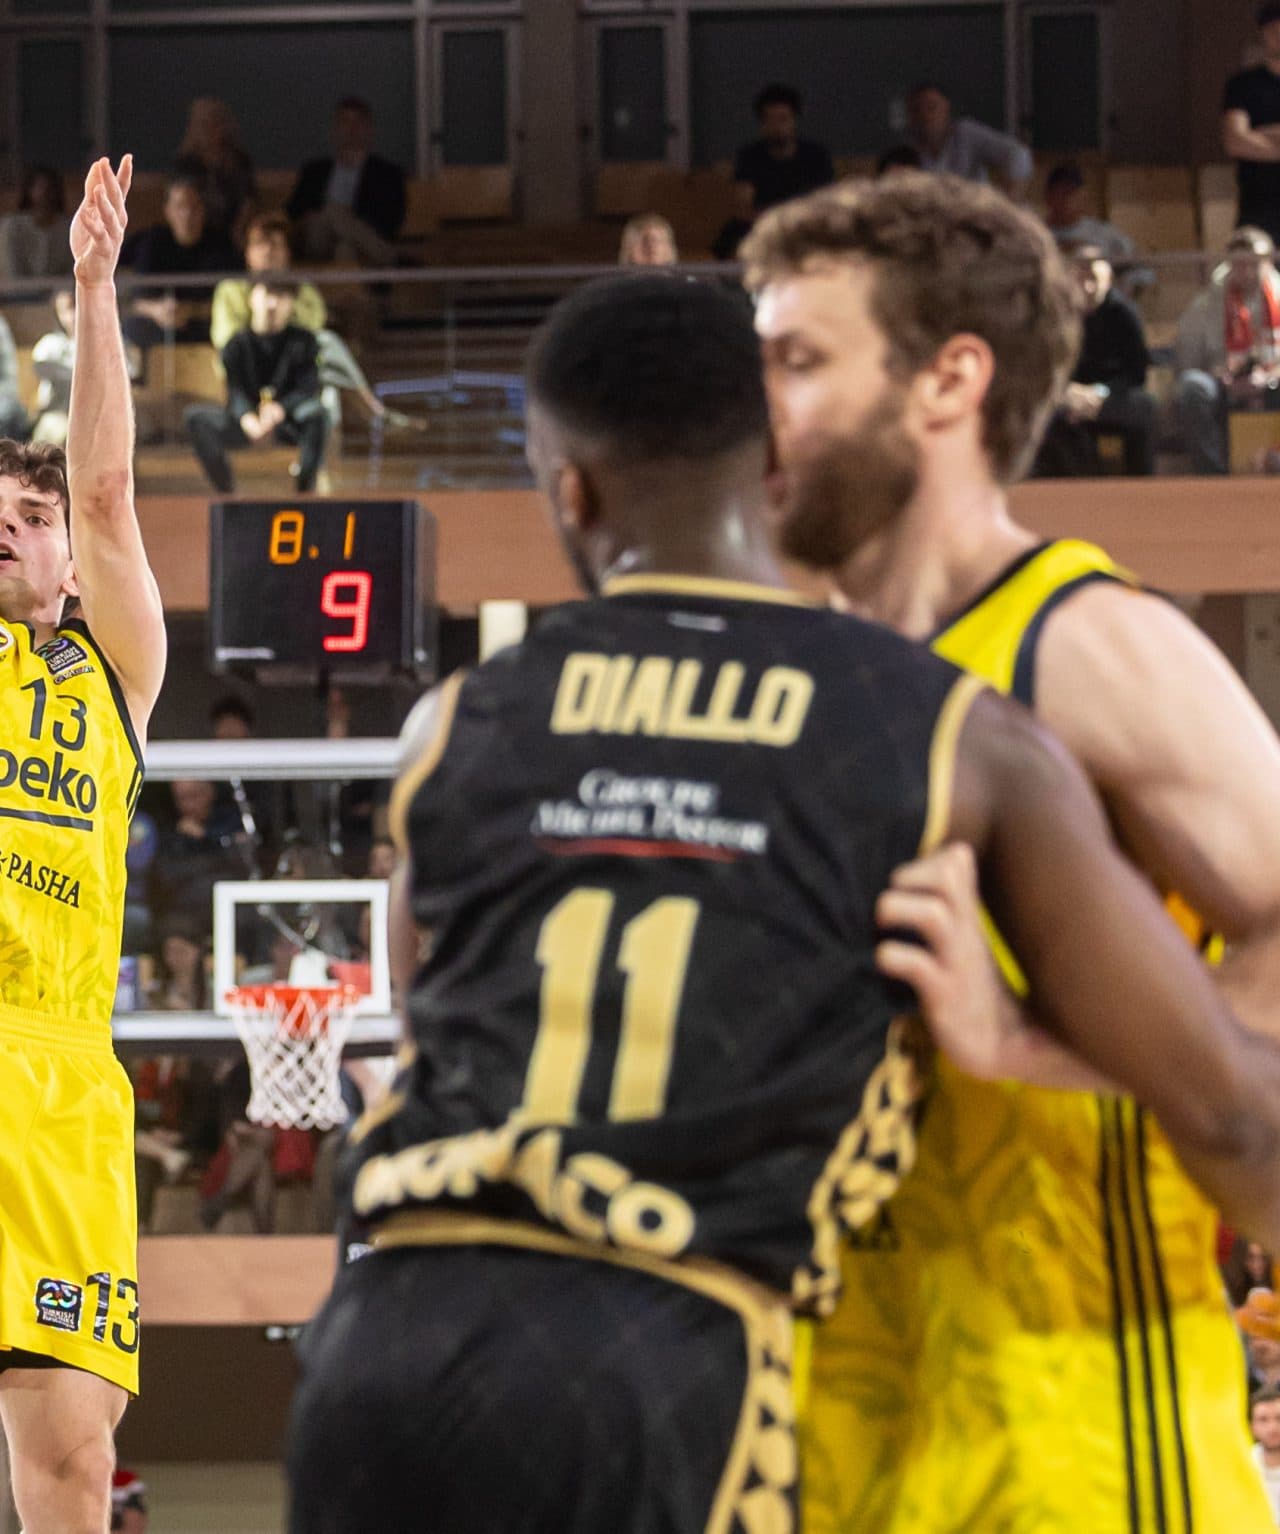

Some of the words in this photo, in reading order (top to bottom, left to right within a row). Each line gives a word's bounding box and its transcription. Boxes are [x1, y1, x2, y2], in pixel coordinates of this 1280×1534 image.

[270, 510, 356, 564] 8.1
[321, 571, 372, 652] 9
[20, 678, 87, 751] 13
[550, 652, 814, 747] DIALLO
[7, 853, 80, 908] PASHA
[521, 886, 699, 1126] 11
[86, 1272, 138, 1353] 13
